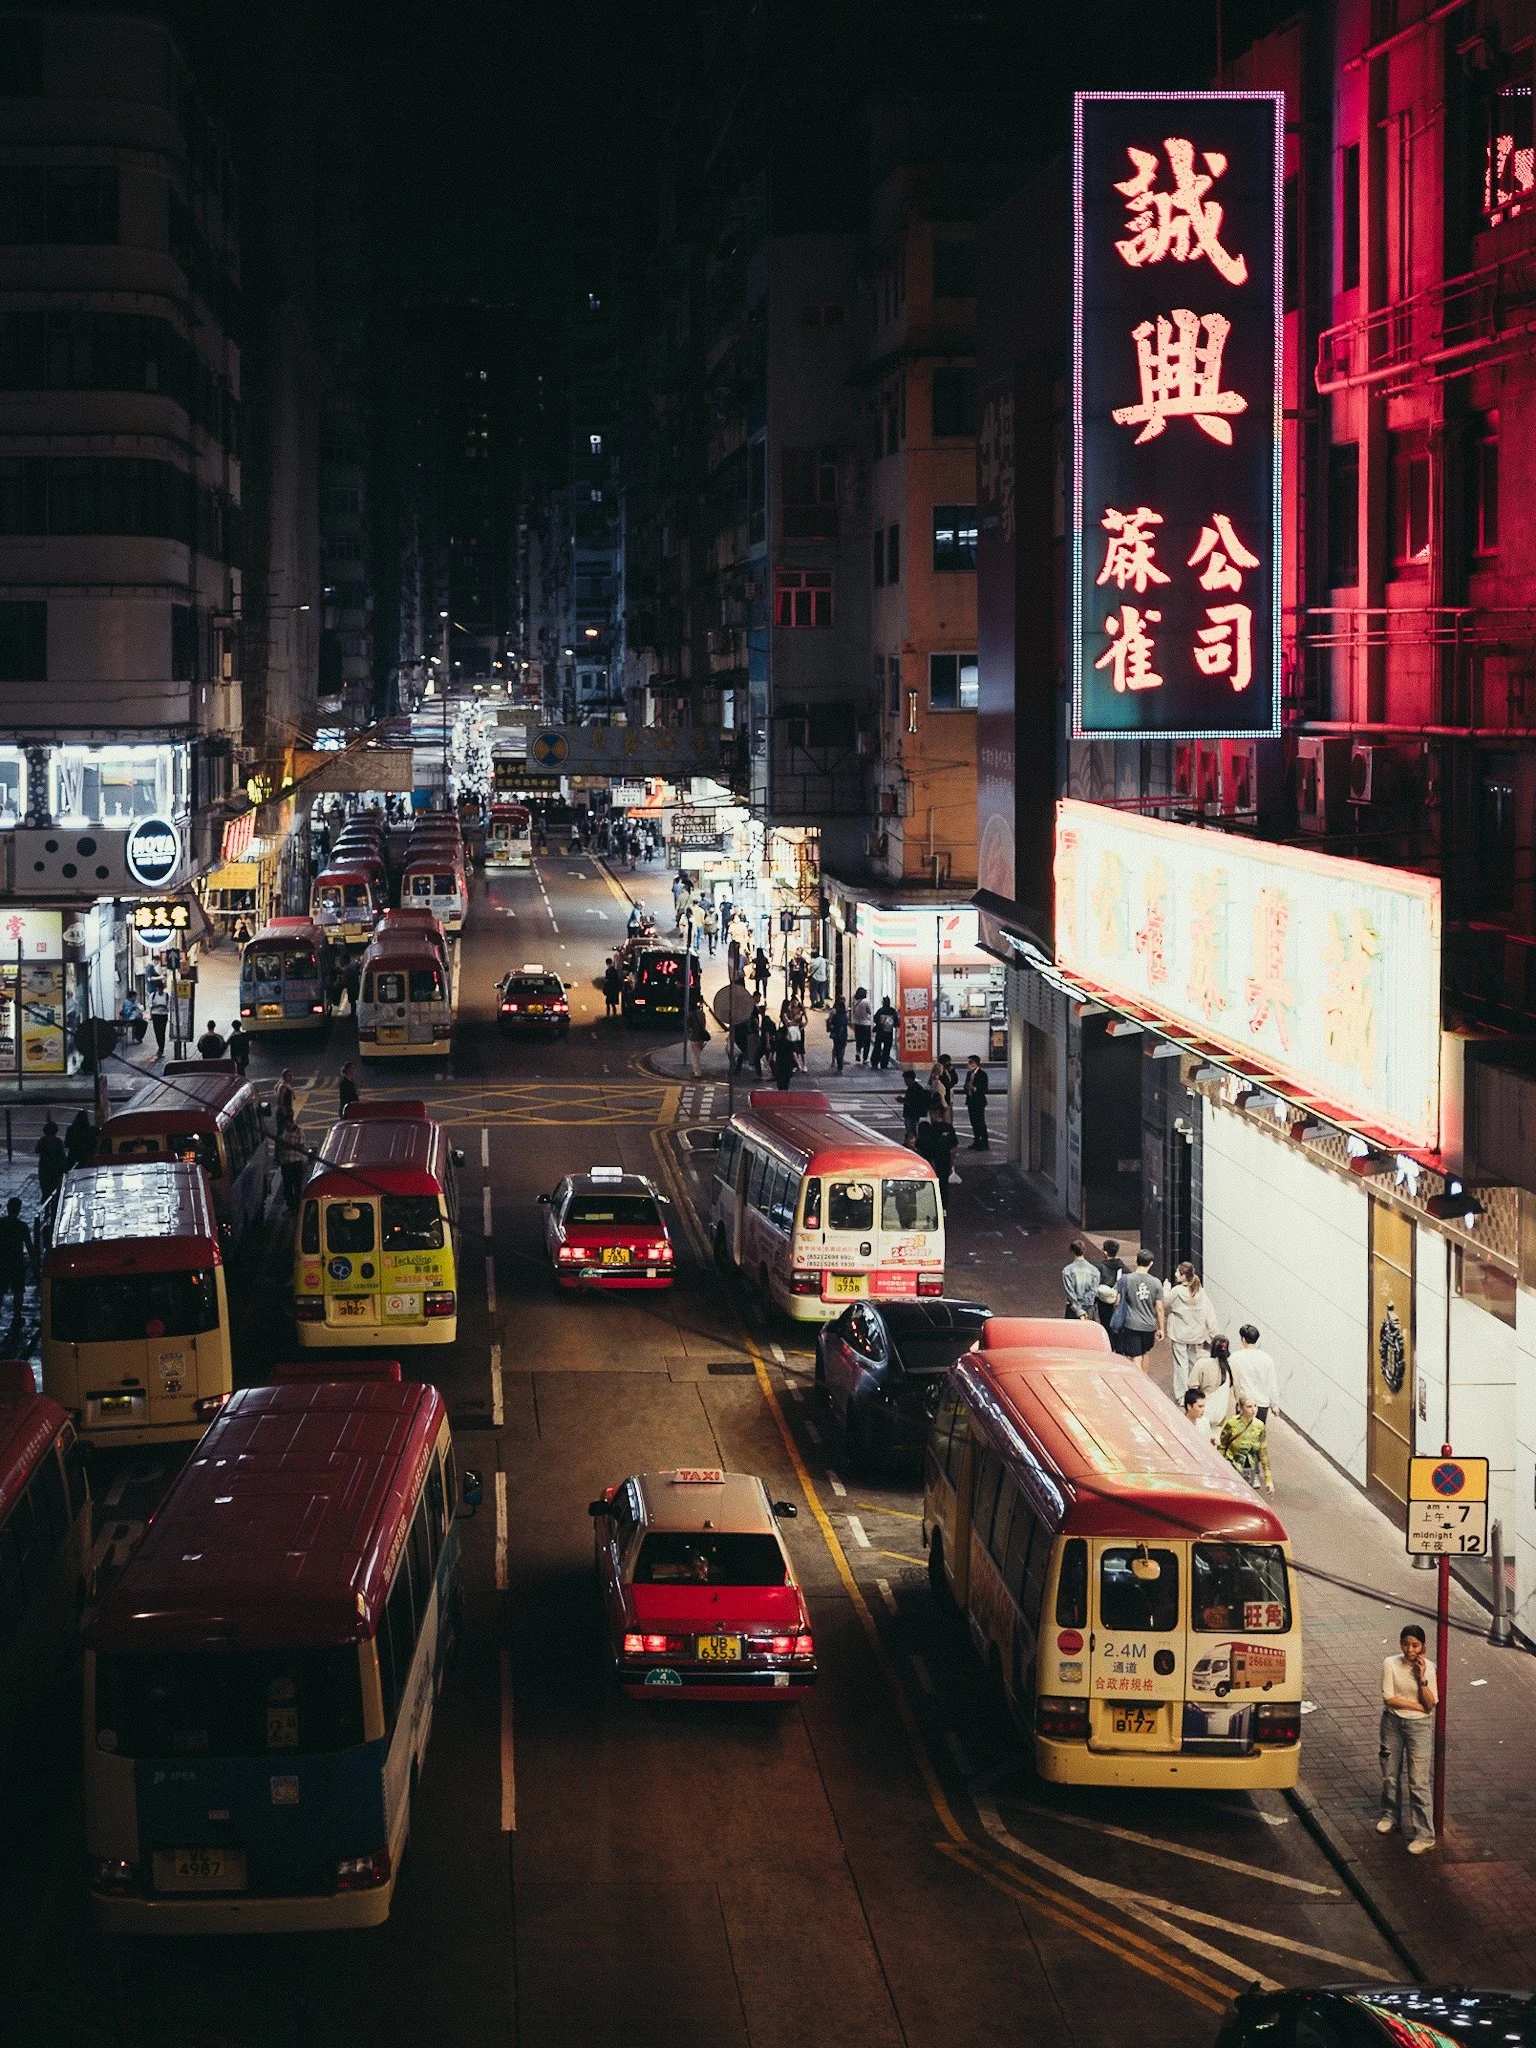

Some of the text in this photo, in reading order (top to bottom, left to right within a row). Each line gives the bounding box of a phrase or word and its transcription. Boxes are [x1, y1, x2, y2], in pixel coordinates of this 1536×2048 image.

[1186, 512, 1261, 692] 公司
[837, 1284, 860, 1292] 3738
[680, 1470, 721, 1481] TAXI
[1422, 1512, 1445, 1522] 上午
[1458, 1505, 1471, 1523] 7
[1412, 1531, 1453, 1540] midnight
[1421, 1540, 1444, 1551] 午夜
[1458, 1534, 1481, 1552] 12
[1244, 1602, 1284, 1629] 旺角
[710, 1638, 728, 1649] UB
[701, 1648, 737, 1659] 6353
[1104, 1642, 1147, 1659] 2.4M
[1112, 1661, 1138, 1674] 通道
[1095, 1677, 1155, 1692] 合政府規格
[1116, 1720, 1156, 1733] 8177
[179, 1861, 221, 1876] 4987
